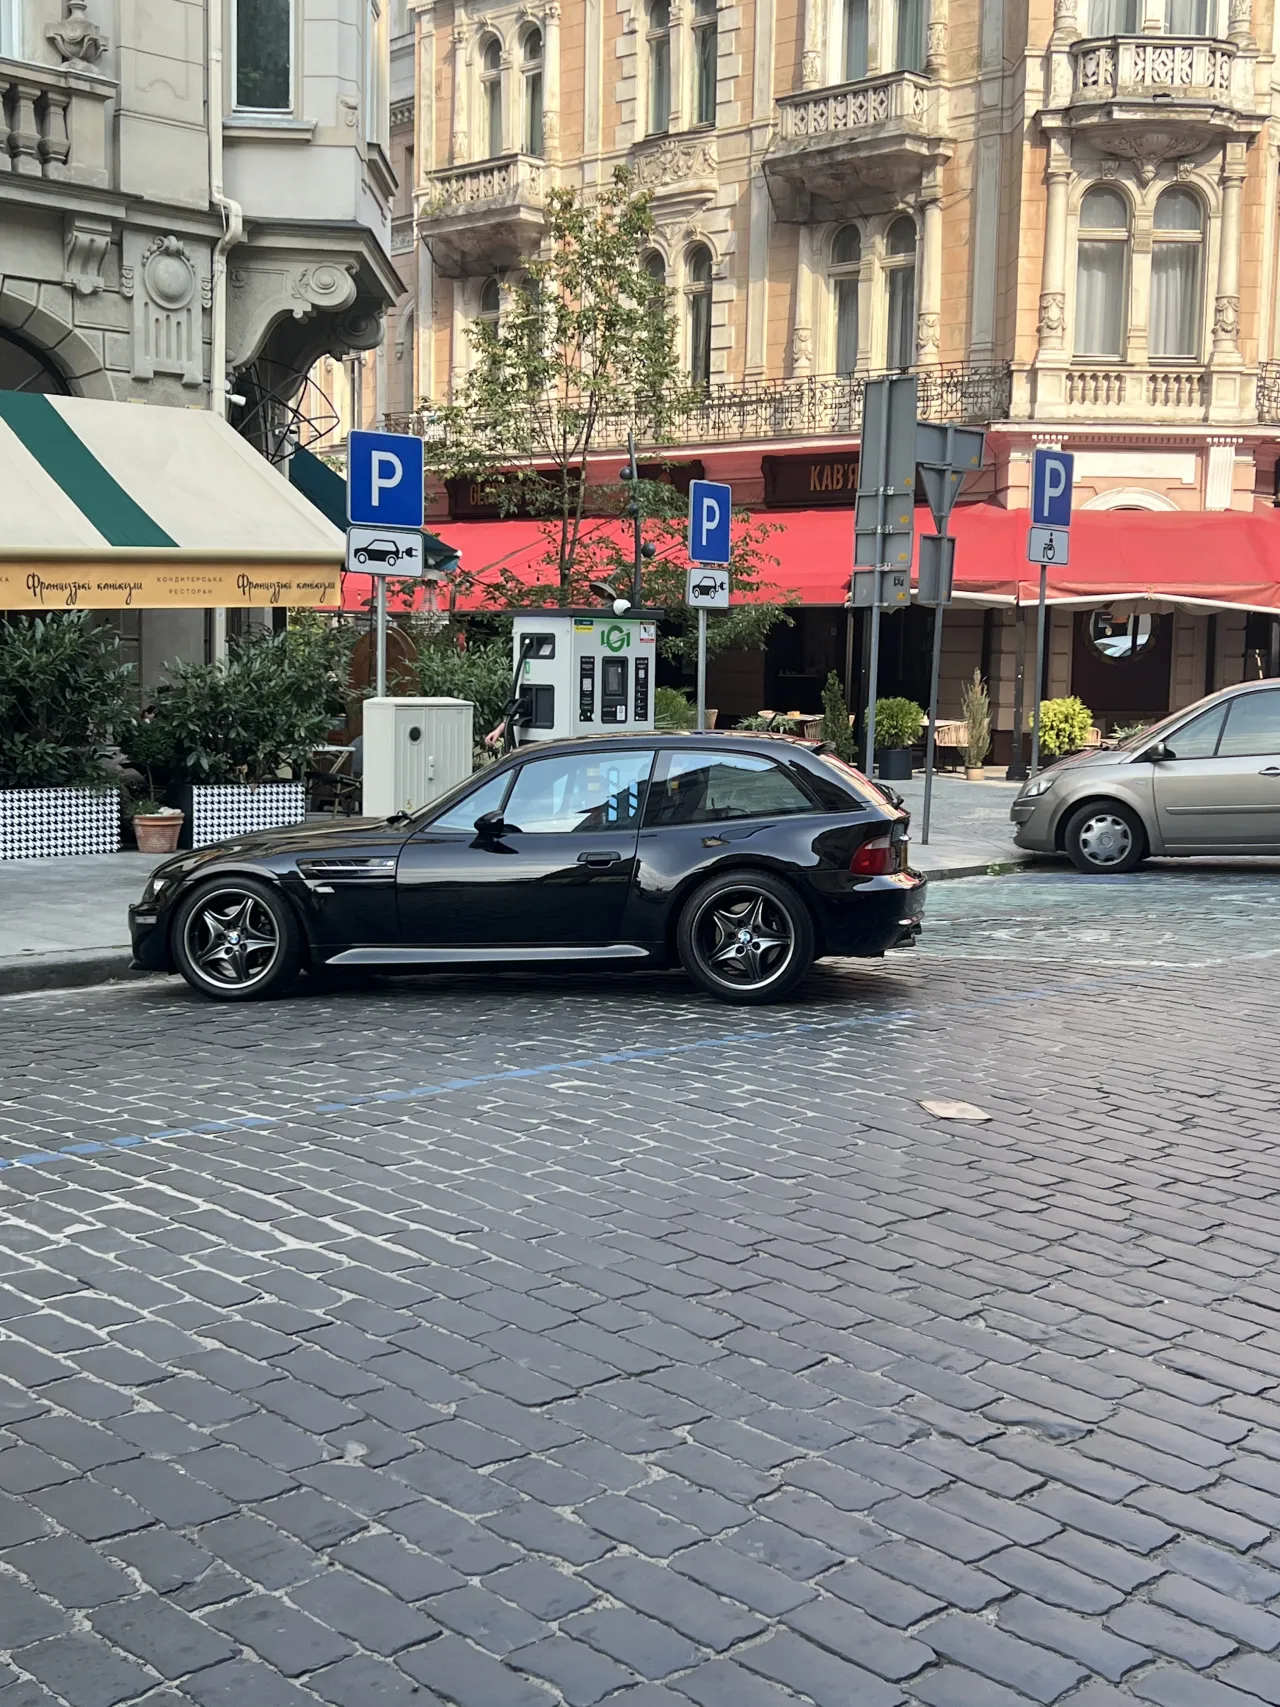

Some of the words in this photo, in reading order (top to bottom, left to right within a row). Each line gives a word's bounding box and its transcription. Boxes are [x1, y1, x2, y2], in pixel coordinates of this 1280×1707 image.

[371, 450, 403, 507] P
[1043, 459, 1066, 517] P
[702, 497, 720, 546] P
[26, 572, 92, 606] Французькі
[97, 580, 143, 606] канікули
[236, 573, 292, 604] Французькі
[296, 580, 336, 603] канікули
